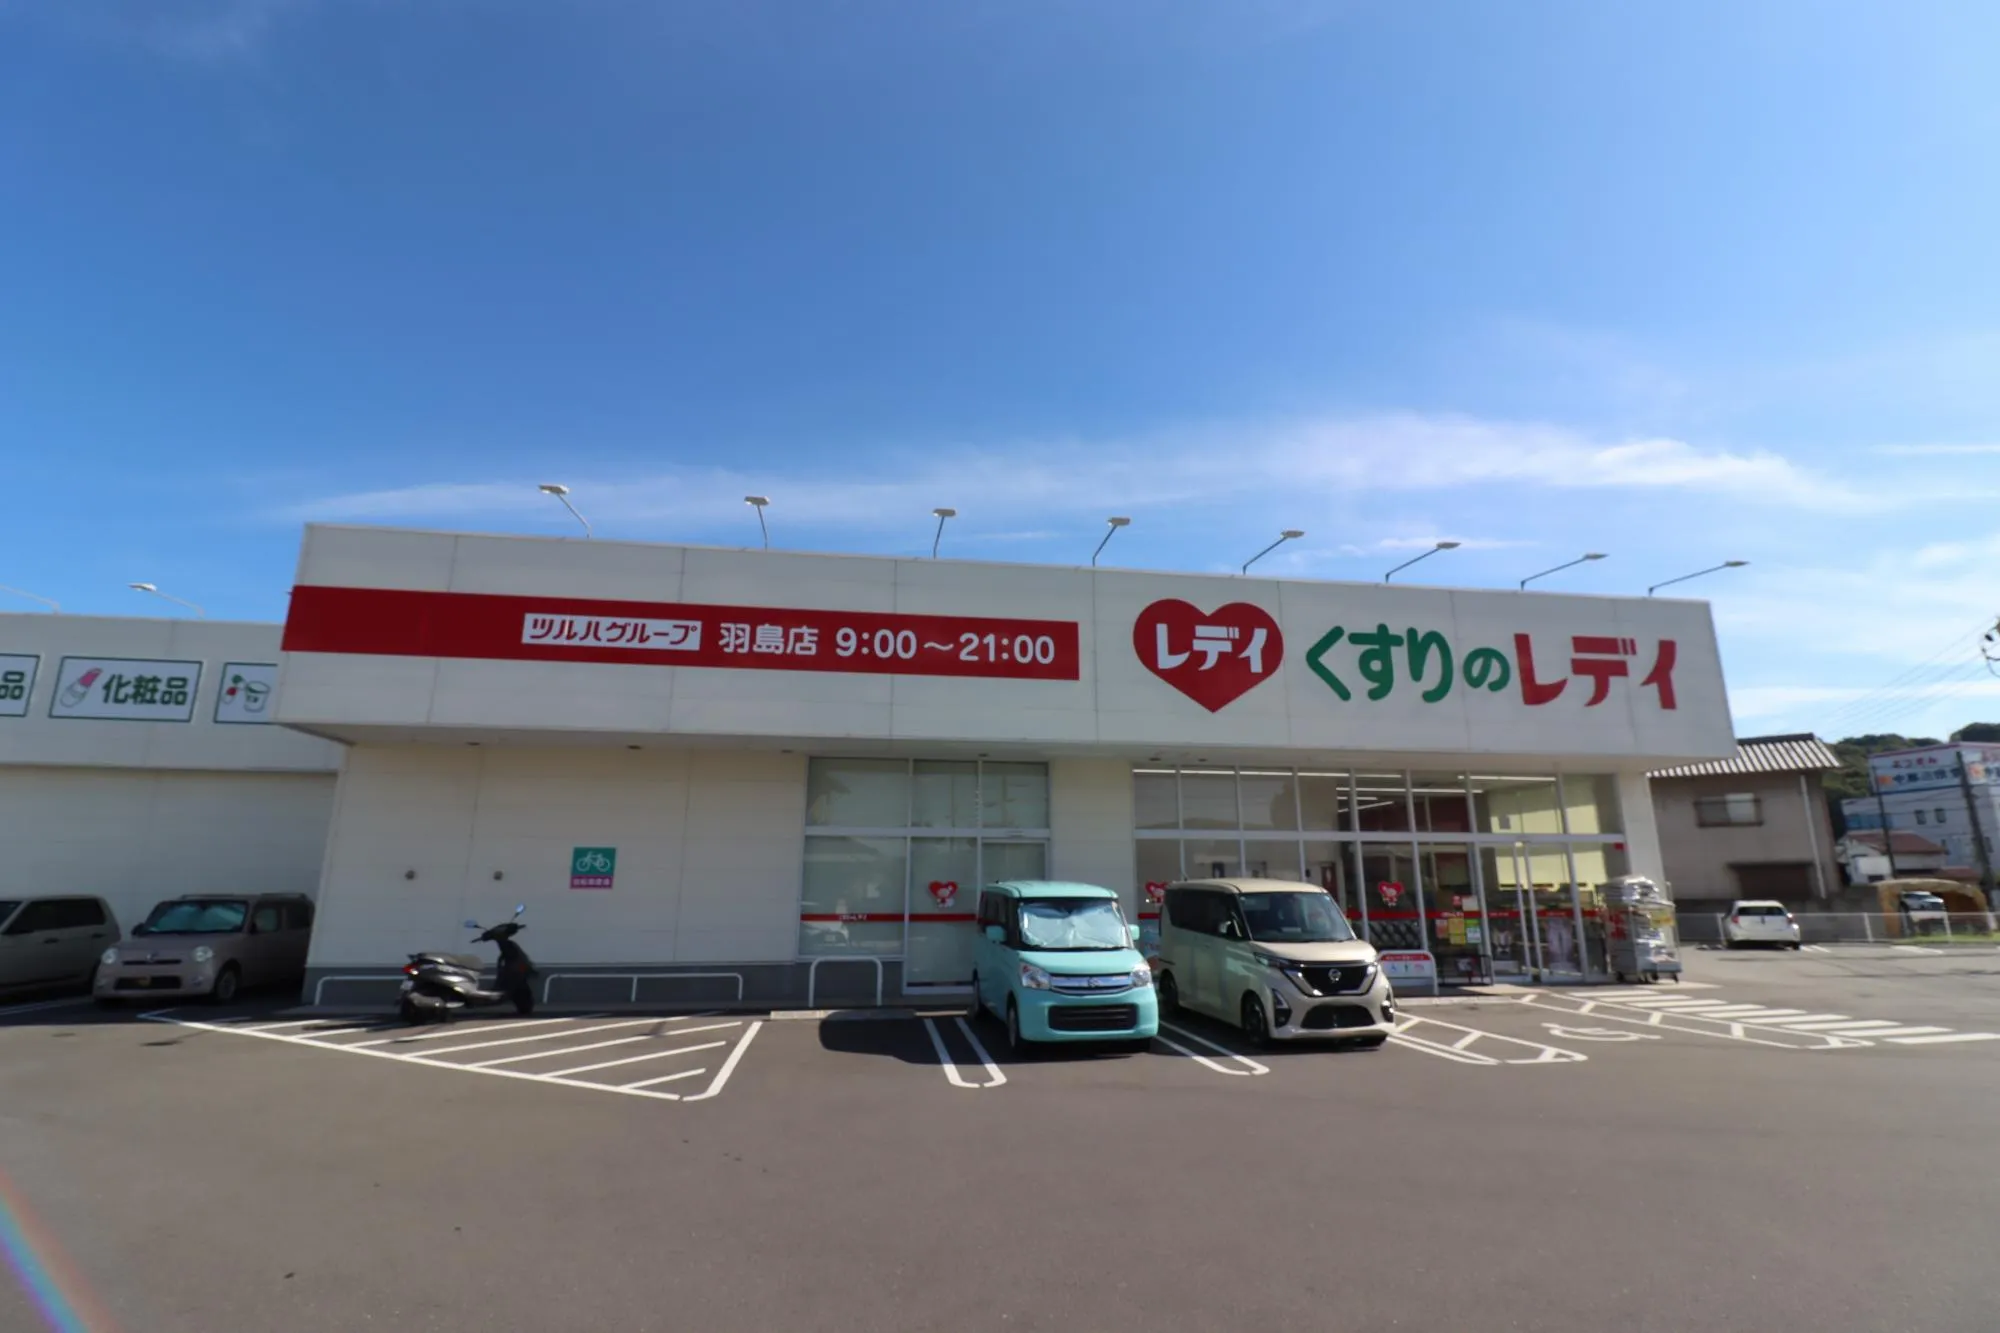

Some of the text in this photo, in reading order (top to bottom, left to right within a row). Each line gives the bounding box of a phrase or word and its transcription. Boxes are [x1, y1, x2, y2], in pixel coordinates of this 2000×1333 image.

[530, 617, 698, 646] ツルハグループ
[718, 622, 819, 656] 羽島店
[0, 670, 25, 701] 品
[102, 673, 188, 706] 化粧品
